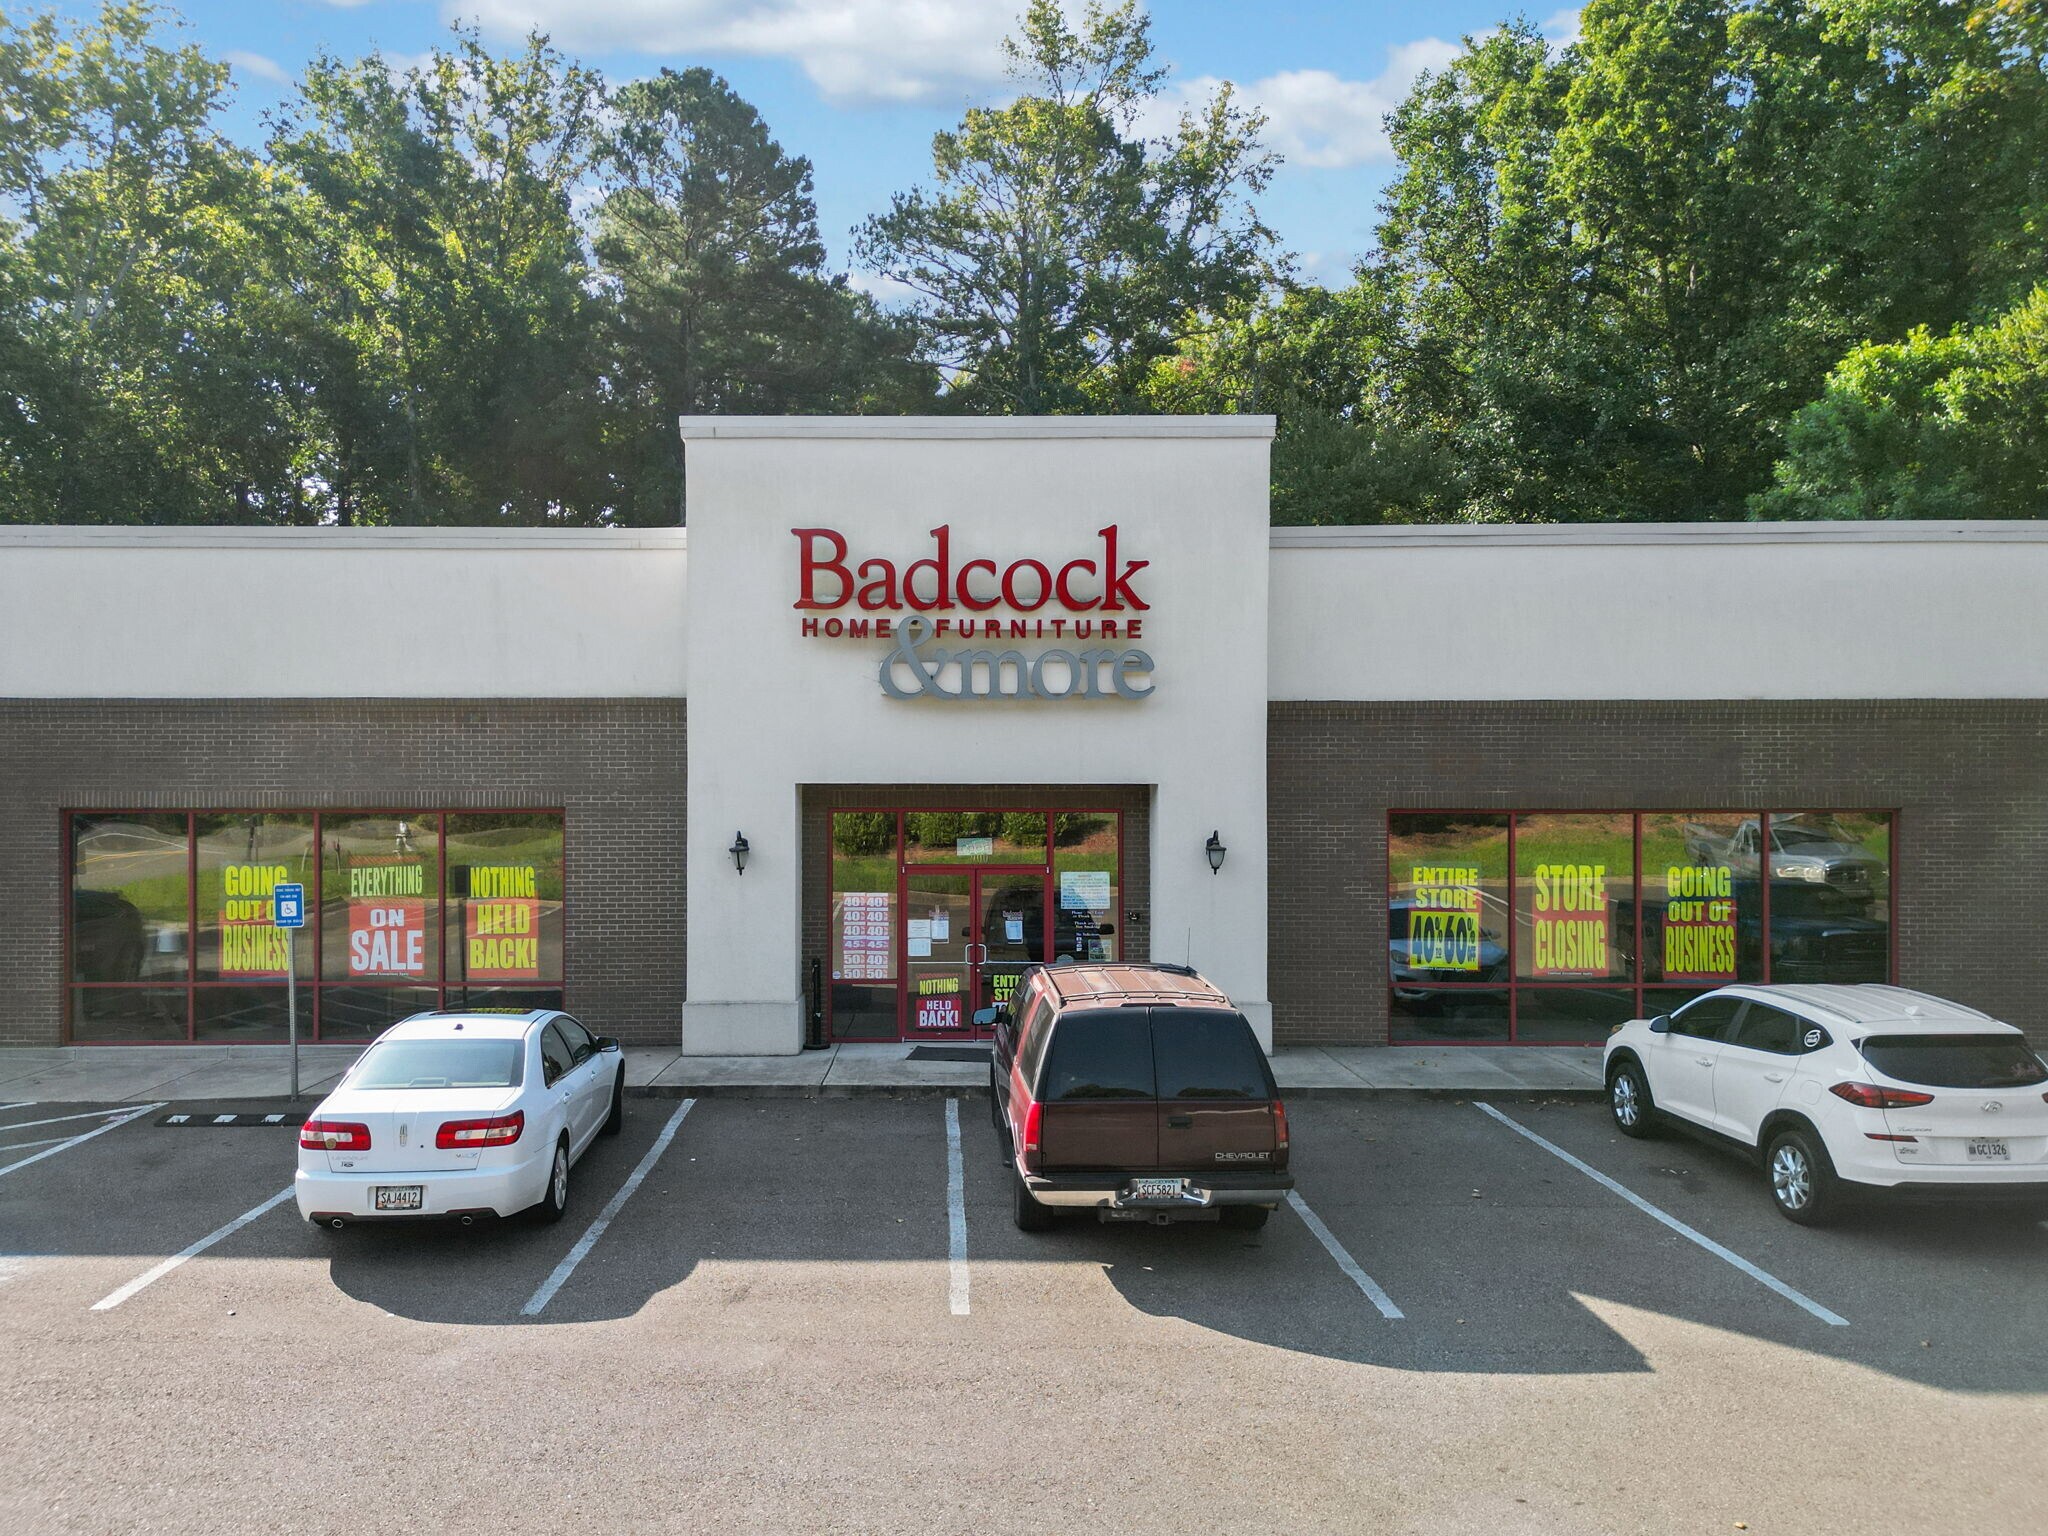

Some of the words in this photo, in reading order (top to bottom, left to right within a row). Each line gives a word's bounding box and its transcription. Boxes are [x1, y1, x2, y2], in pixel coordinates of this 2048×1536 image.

[791, 524, 1151, 612] Badcock
[801, 617, 892, 639] HOME
[936, 618, 1143, 640] FURNITURE
[225, 865, 288, 896] GOING
[351, 865, 423, 897] EVERYTHING
[470, 866, 536, 898] NOTHING
[1413, 867, 1478, 886] ENTIRE
[1535, 864, 1606, 912] STORE
[1667, 866, 1731, 897] GOING
[226, 899, 261, 921] OUT
[266, 899, 275, 921] O
[1415, 888, 1477, 909] STORE
[1668, 900, 1704, 922] OUT
[1708, 900, 1731, 922] OF
[370, 908, 404, 928] ON
[477, 904, 530, 935] HELD
[223, 923, 289, 971] BUSINESS
[351, 929, 423, 971] SALE
[469, 938, 538, 969] BACK!
[1535, 919, 1606, 969] CLOSING
[1665, 925, 1735, 973] BUSINESS
[920, 978, 959, 996] NOTHING
[993, 975, 1022, 988] ENTI
[920, 1010, 959, 1026] BACK!
[926, 1000, 951, 1010] HELD
[381, 1192, 418, 1204] SAJ4412
